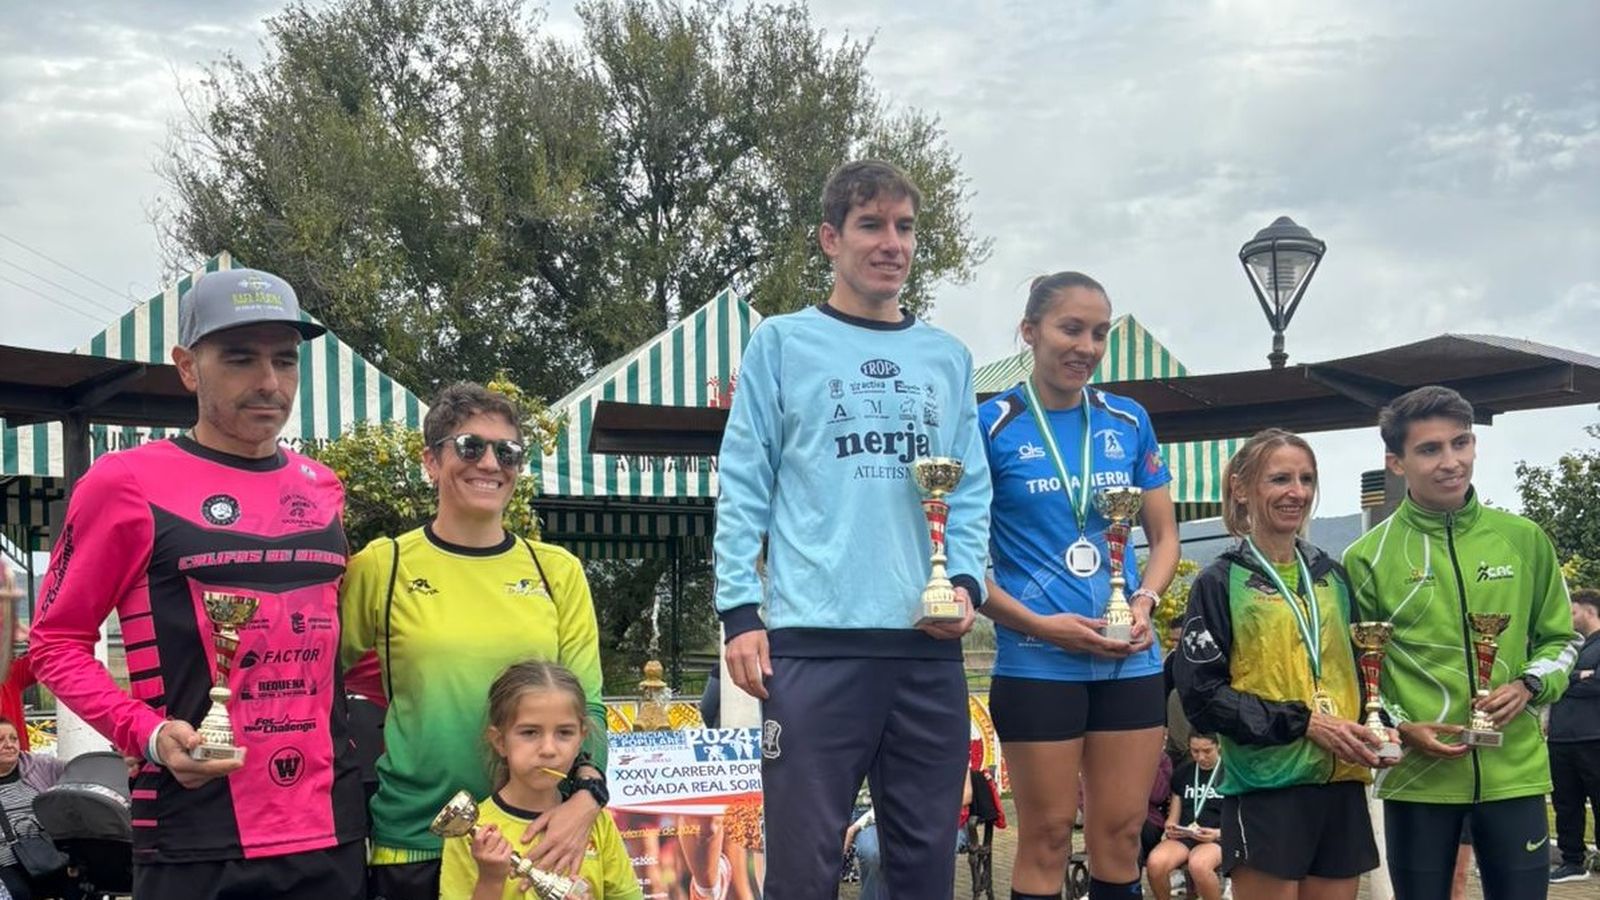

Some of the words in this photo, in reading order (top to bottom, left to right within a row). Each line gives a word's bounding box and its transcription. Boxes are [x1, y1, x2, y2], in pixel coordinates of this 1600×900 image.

[861, 360, 899, 376] TROPS
[835, 423, 930, 463] nerja
[1026, 471, 1131, 494] TROAIERRA
[263, 648, 319, 664] FACTOR
[258, 679, 306, 692] REQUENA
[690, 728, 751, 745] 2024
[615, 767, 658, 781] XXXIV
[661, 765, 726, 778] CARRERA
[623, 779, 689, 796] CAÑADA
[692, 780, 728, 793] REAL
